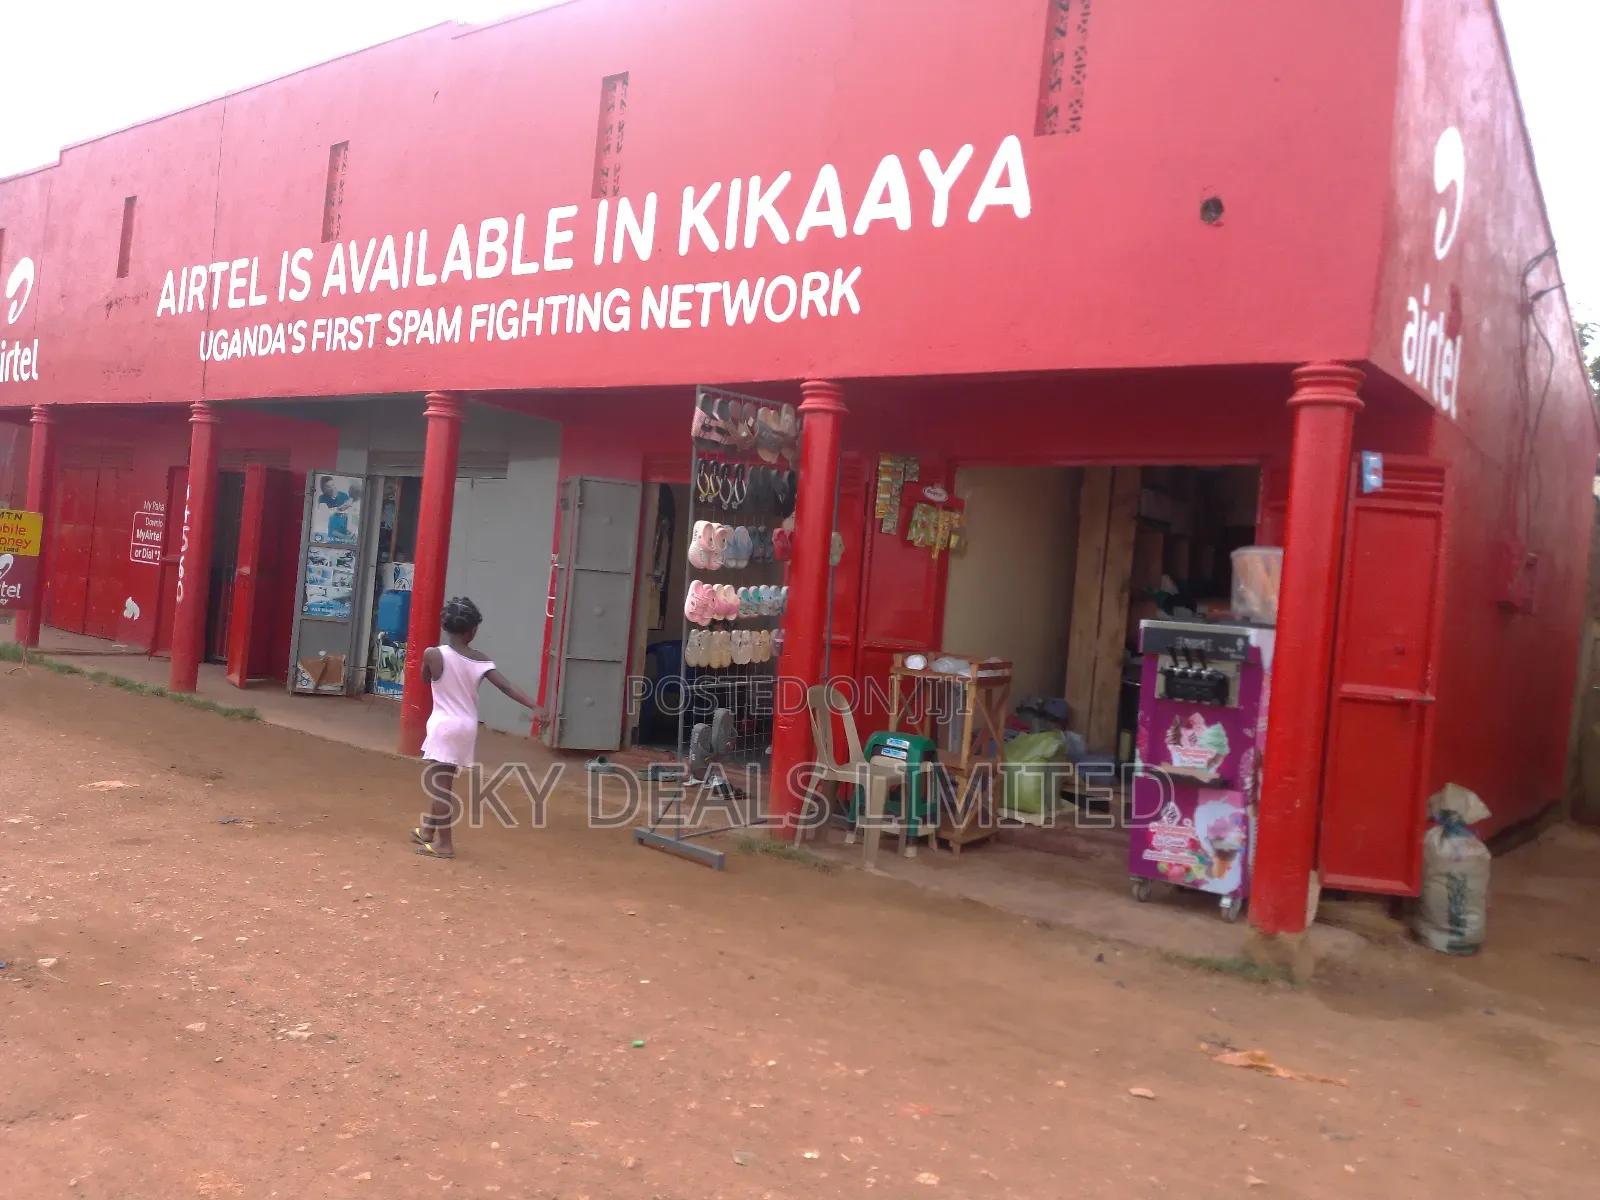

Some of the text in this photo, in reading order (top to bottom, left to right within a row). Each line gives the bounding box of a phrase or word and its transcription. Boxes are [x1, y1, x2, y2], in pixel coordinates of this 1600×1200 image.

[157, 135, 1031, 317] AIRTEL IS AVAILABLE IN KIKAAYA
[199, 267, 861, 361] UGANDA'S FIRST SPAM FIGHTING NETWORK
[1402, 284, 1462, 420] airtel
[0, 339, 39, 383] irtel
[0, 524, 26, 535] bile
[136, 529, 162, 542] MyAirtel
[0, 536, 32, 549] oney
[134, 550, 141, 558] or
[142, 548, 154, 559] Dial
[0, 581, 21, 598] tel
